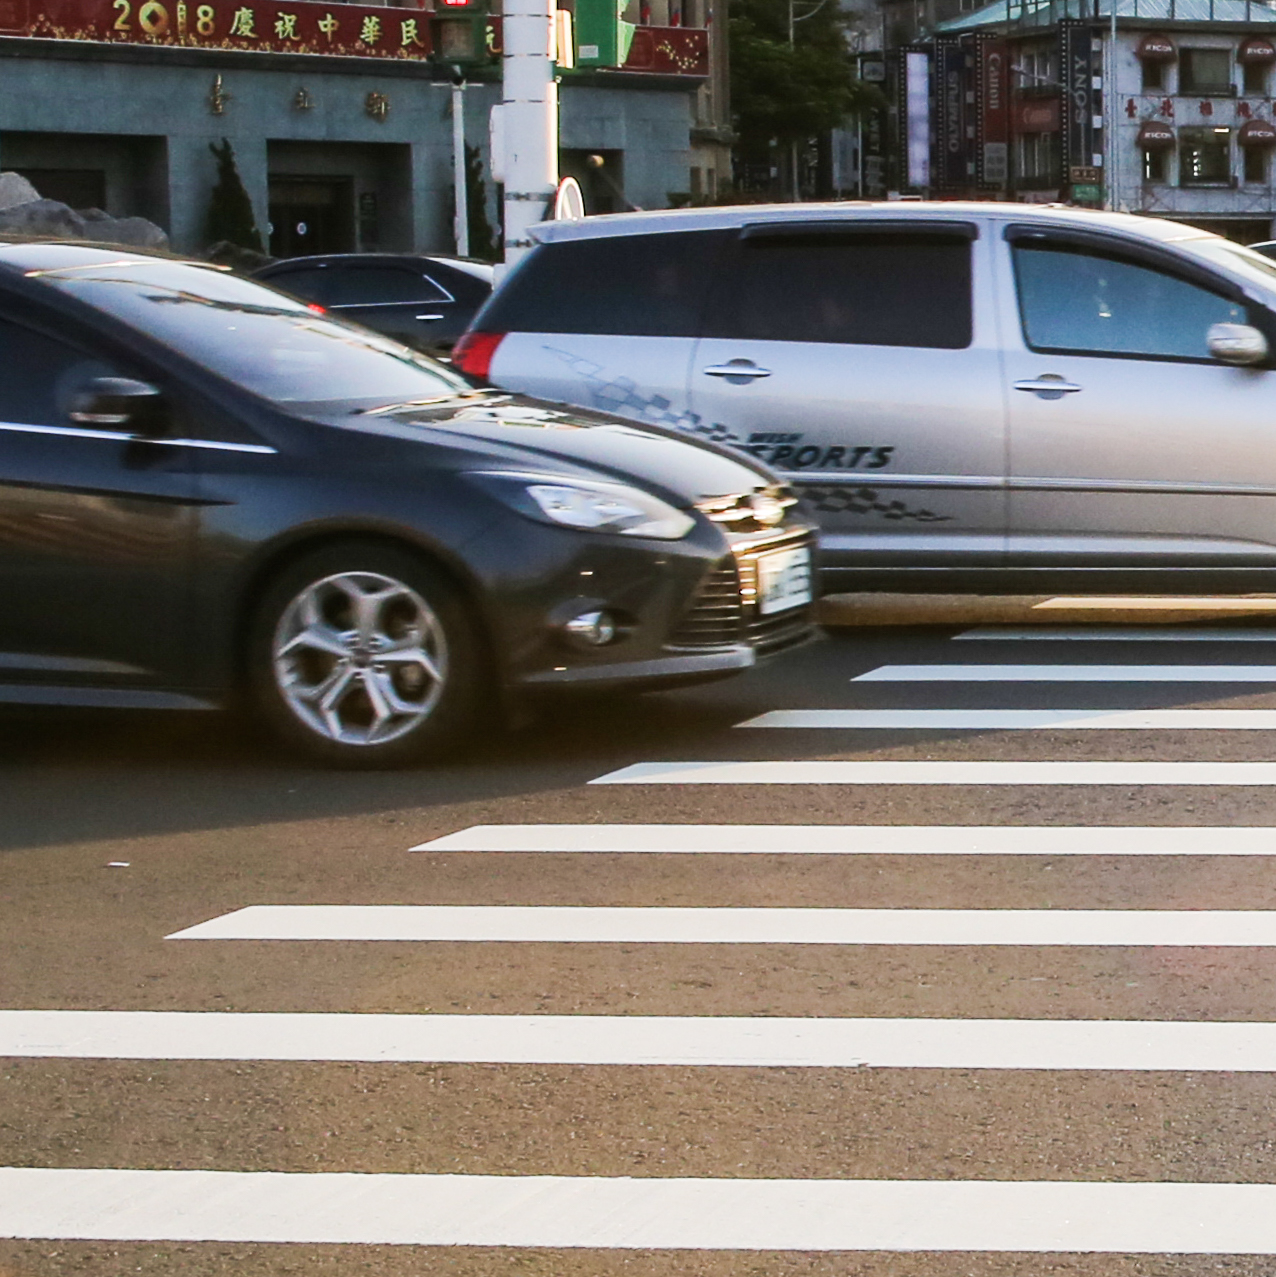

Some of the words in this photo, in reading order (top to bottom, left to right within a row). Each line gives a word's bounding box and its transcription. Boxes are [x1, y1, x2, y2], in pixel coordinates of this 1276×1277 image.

[948, 71, 959, 153] OLYMPUS
[989, 52, 1000, 110] Canon
[1074, 56, 1087, 124] SONY
